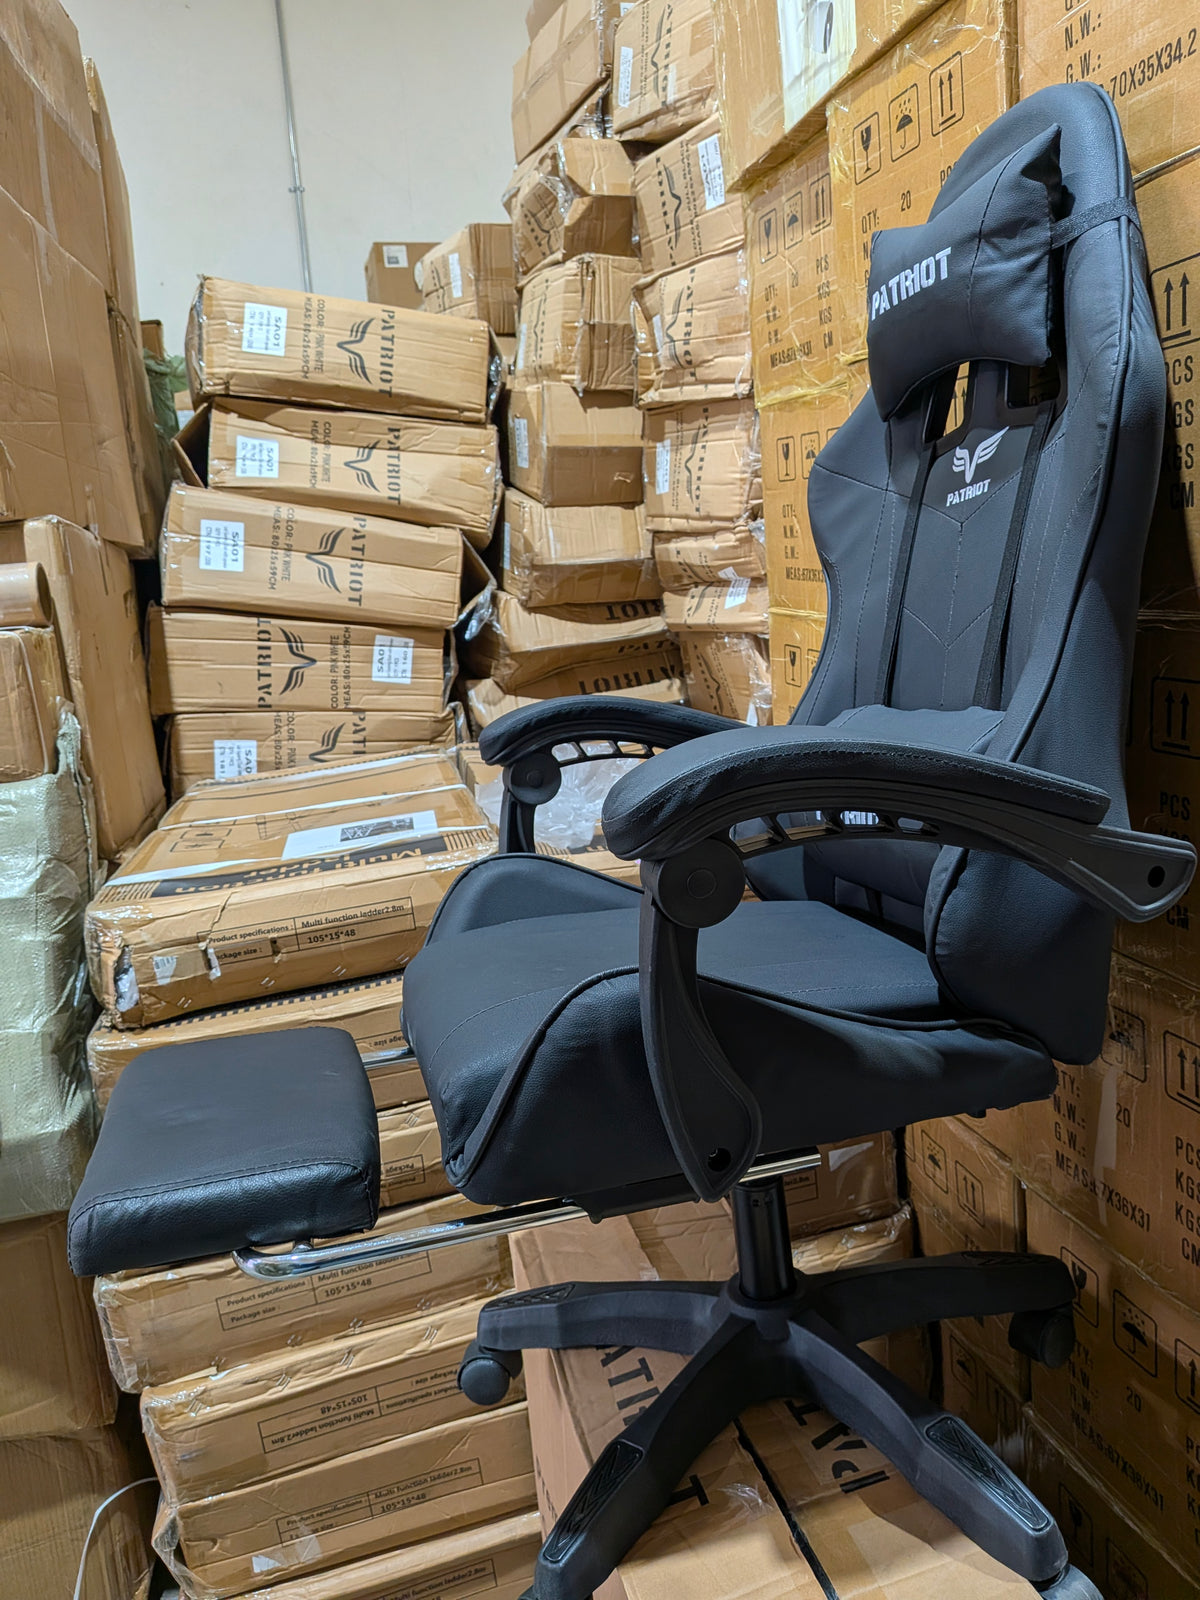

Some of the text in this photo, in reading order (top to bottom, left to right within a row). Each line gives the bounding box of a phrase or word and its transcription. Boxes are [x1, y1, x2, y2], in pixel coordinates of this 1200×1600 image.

[1064, 10, 1101, 51] N.W.:
[1099, 28, 1197, 101] 70X35X34.2
[862, 208, 880, 233] QTY:
[900, 190, 911, 212] 20
[871, 247, 952, 322] PATRIOT
[303, 297, 313, 322] MEAS:
[315, 299, 326, 327] COLOR:
[272, 316, 282, 348] SA01
[379, 309, 396, 397] PATRIOT
[322, 421, 332, 451] COLOR:
[387, 427, 402, 505] PATRIOT
[946, 479, 991, 507] PATRIOT
[1170, 481, 1194, 509] CM
[271, 505, 282, 534] MEAS:
[284, 508, 295, 541] COLOR:
[231, 531, 241, 563] SA01
[348, 516, 366, 607] PATRIOT
[280, 560, 292, 581] WHITE
[330, 634, 339, 657] WHITE
[257, 617, 272, 709] PATRIOT
[330, 675, 339, 709] COLOR:
[343, 681, 351, 709] MEAS:
[273, 712, 282, 738] MEAS:
[286, 711, 296, 742] COLOR:
[1160, 792, 1190, 821] PCS
[333, 847, 422, 872] Multi
[208, 932, 238, 944] Product
[239, 925, 289, 940] specifications
[301, 918, 323, 929] Multi
[324, 911, 359, 926] function
[216, 950, 242, 961] ackage
[243, 947, 257, 957] size
[1057, 1069, 1082, 1098] TY:
[1053, 1094, 1087, 1130] N.W.:
[1115, 1102, 1131, 1128] 20
[1054, 1121, 1087, 1158] G.W.:
[226, 1293, 257, 1306] Product
[258, 1281, 307, 1299] specifications
[318, 1271, 339, 1282] Multi
[230, 1311, 261, 1323] Package
[262, 1306, 276, 1315] size
[415, 1377, 428, 1385] size
[430, 1369, 458, 1381] Package
[386, 1391, 433, 1410] specifications
[434, 1384, 459, 1397] roduct
[1126, 1386, 1143, 1413] 20
[318, 1414, 352, 1431] function
[355, 1408, 375, 1422] Multi
[374, 1489, 396, 1499] Multi
[396, 1477, 428, 1492] function
